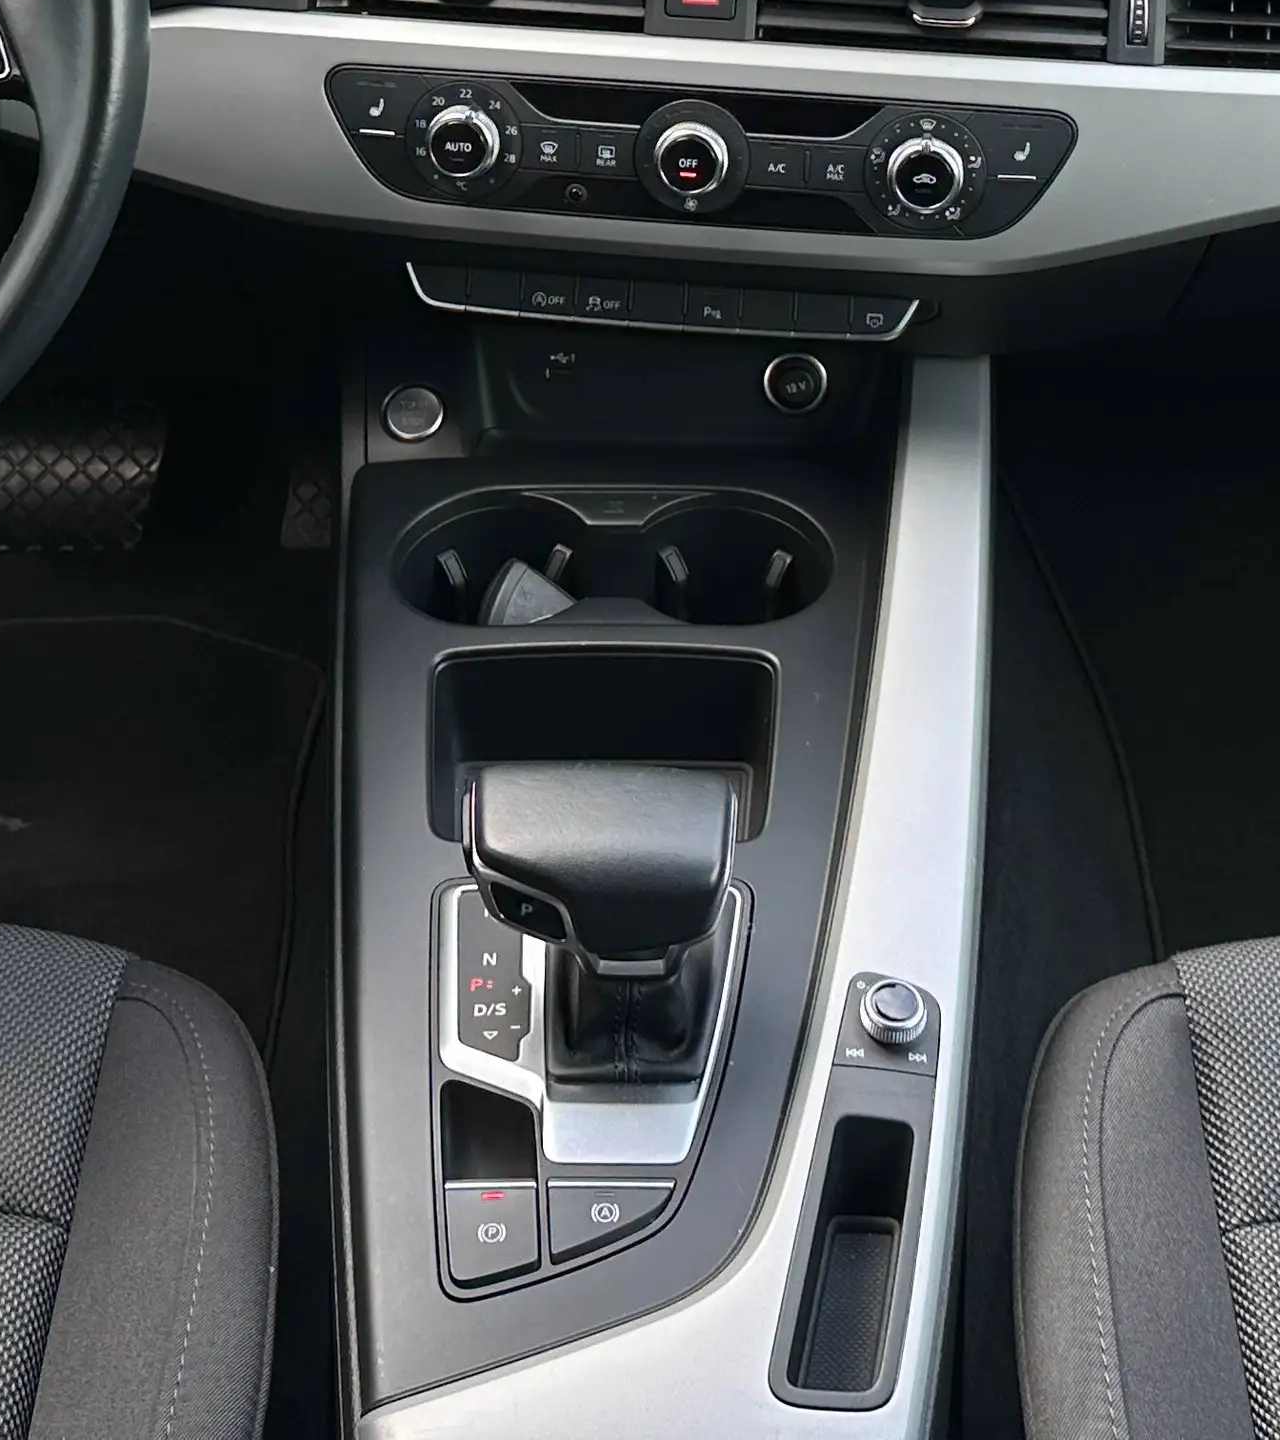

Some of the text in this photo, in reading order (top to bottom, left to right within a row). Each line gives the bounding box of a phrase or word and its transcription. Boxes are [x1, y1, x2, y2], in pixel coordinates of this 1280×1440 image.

[459, 88, 473, 99] 22
[432, 96, 446, 106] 20
[488, 100, 501, 110] 24
[415, 119, 427, 129] 18
[504, 125, 518, 136] 26
[444, 141, 472, 153] AUTO
[503, 153, 516, 164] 28
[595, 158, 617, 168] REAR
[678, 158, 699, 169] OFF
[767, 163, 787, 174] A/C
[826, 163, 845, 174] A/C
[547, 296, 566, 306] OFF
[603, 300, 621, 310] OFF
[520, 903, 533, 917] P
[482, 952, 498, 966] N
[470, 978, 484, 992] P
[473, 1003, 507, 1017] D/S
